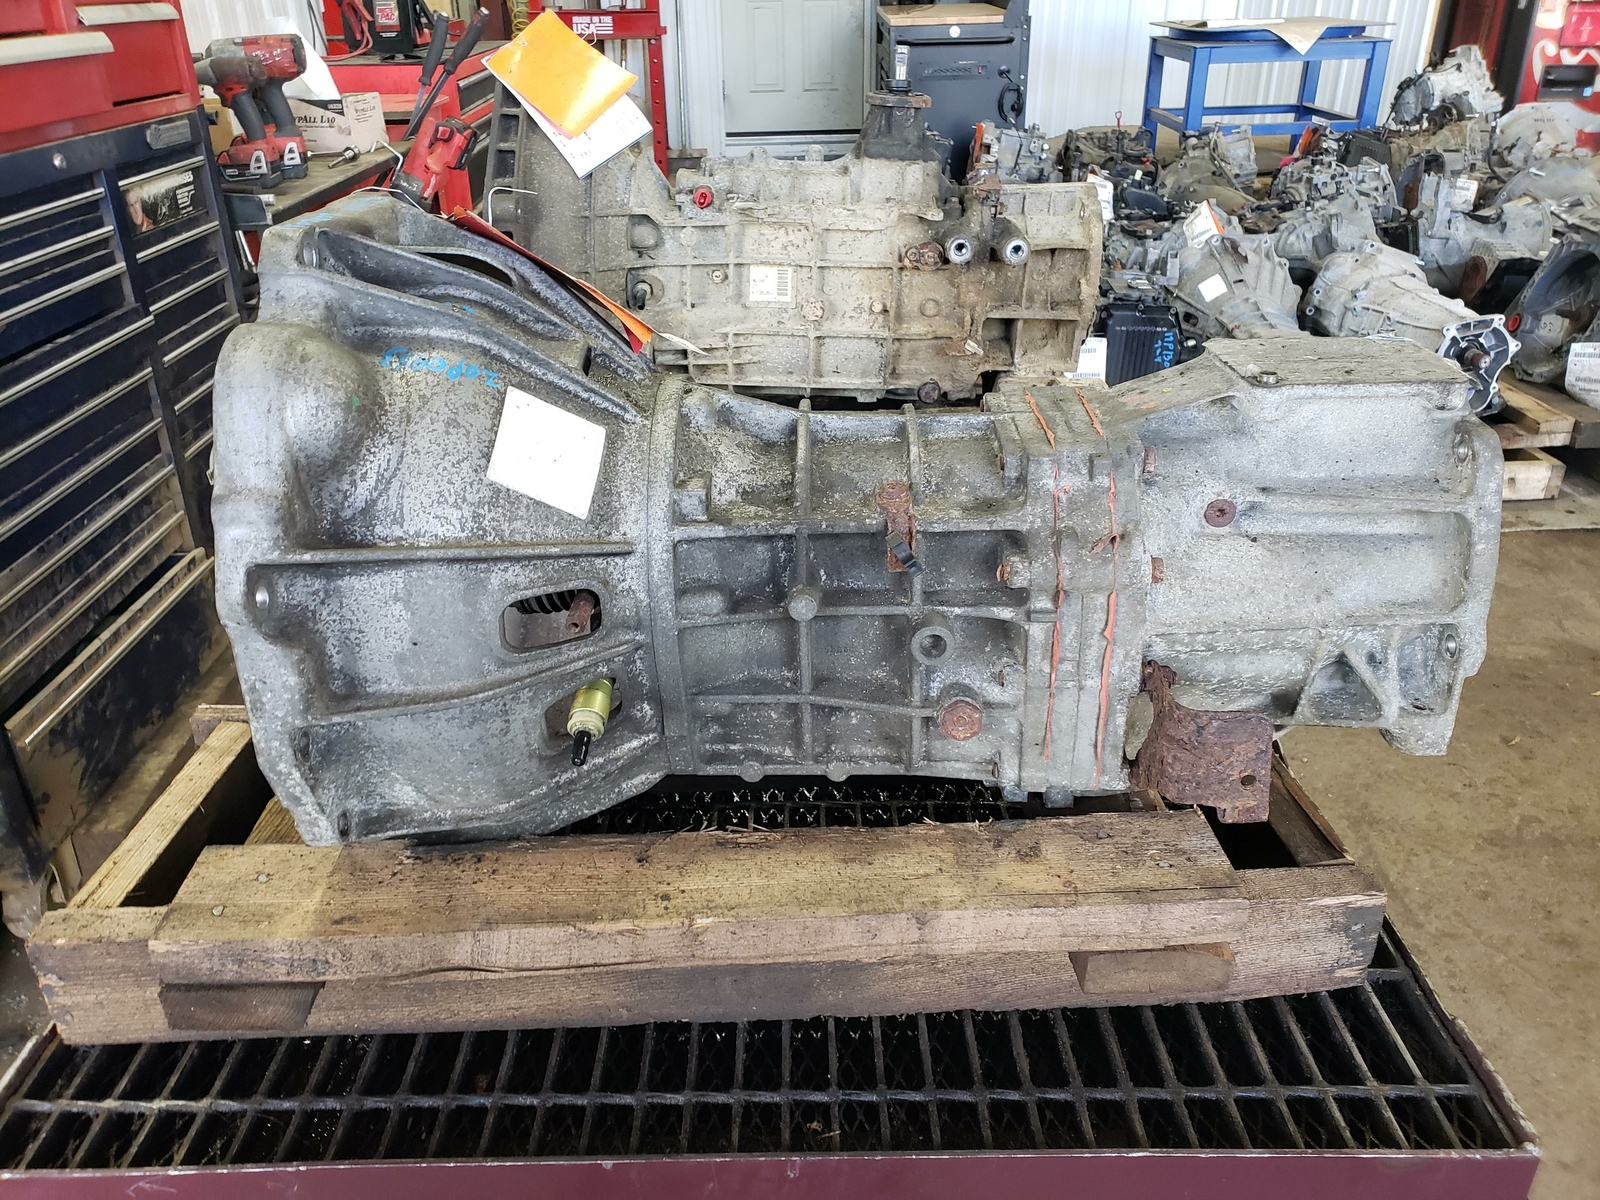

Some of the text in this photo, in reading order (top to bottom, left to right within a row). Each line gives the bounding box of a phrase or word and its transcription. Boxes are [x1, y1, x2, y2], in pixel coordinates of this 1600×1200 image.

[572, 16, 613, 24] MADE IN THE
[572, 23, 597, 35] USA
[320, 115, 335, 124] L10
